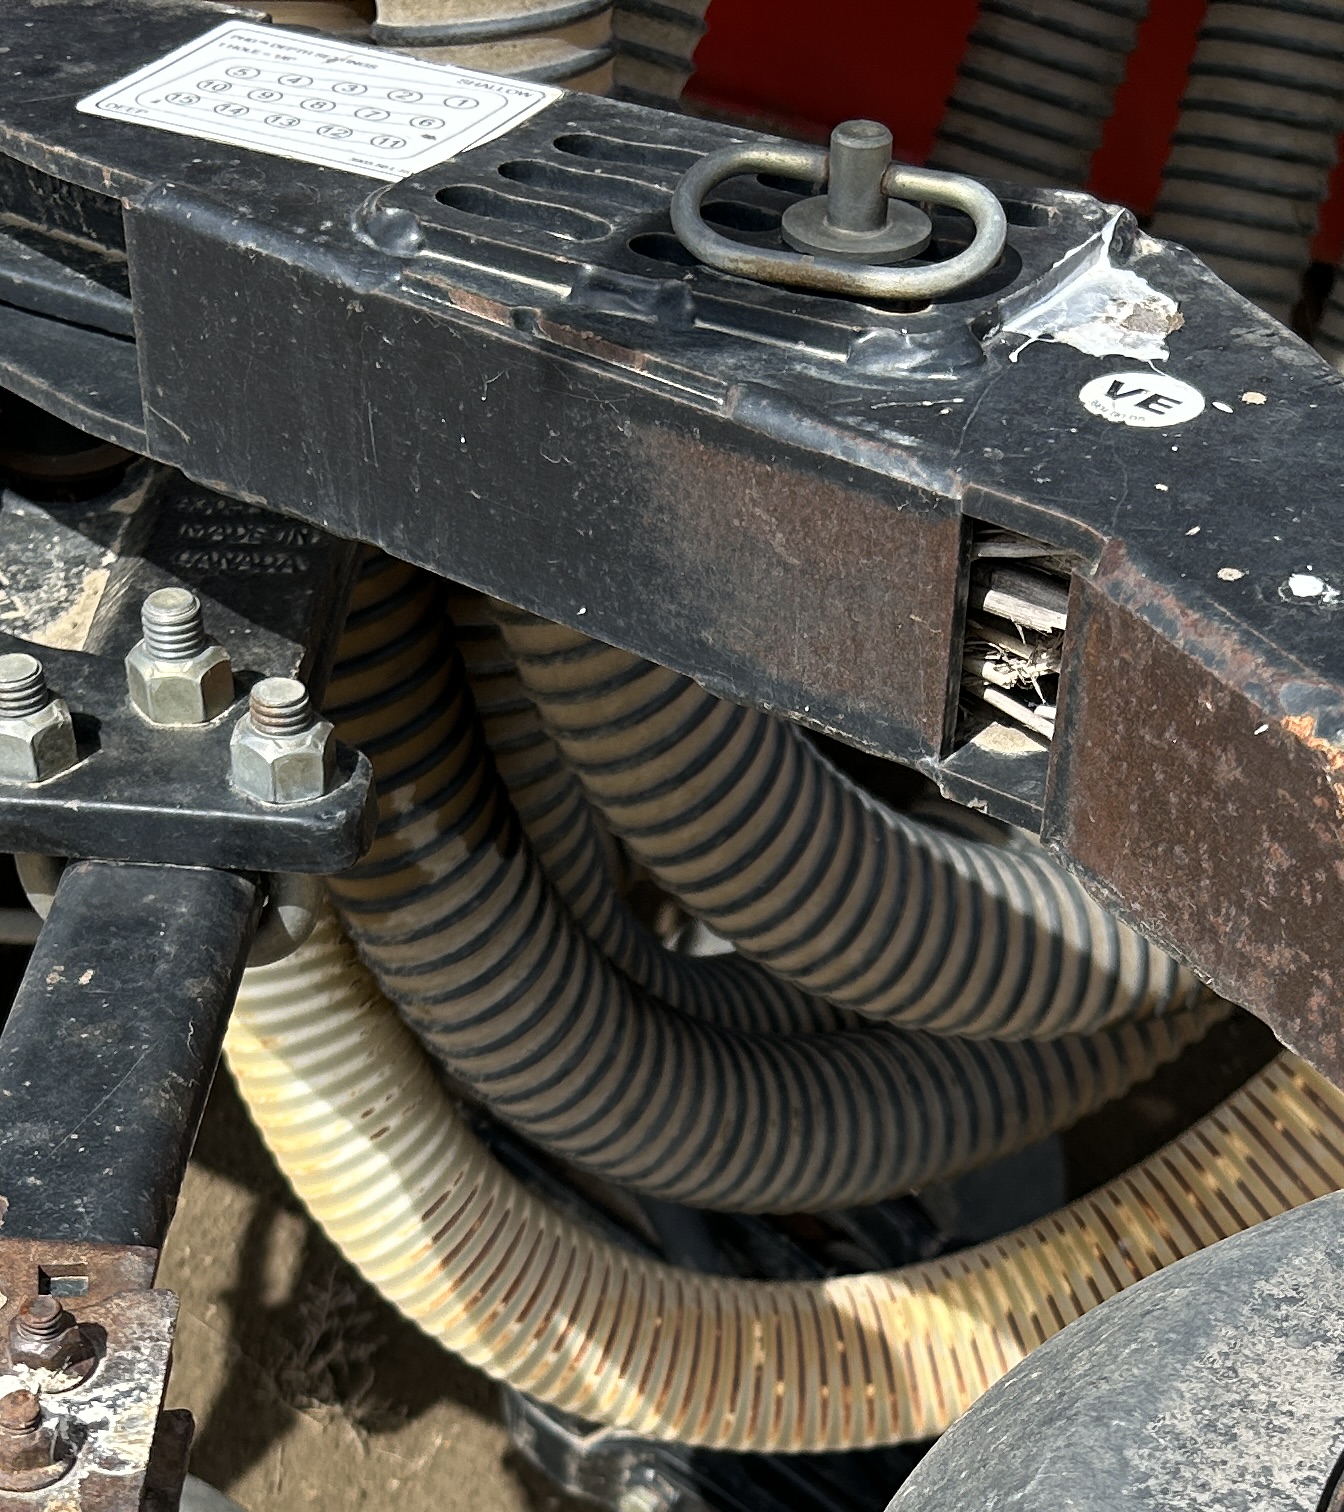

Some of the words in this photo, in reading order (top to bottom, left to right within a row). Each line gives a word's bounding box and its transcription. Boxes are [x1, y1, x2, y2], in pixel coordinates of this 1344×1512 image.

[203, 81, 228, 92] 10
[457, 79, 534, 98] SHALLOW
[104, 102, 150, 114] DEEP
[171, 93, 195, 105] 15
[219, 104, 244, 116] 14
[271, 115, 297, 127] 13
[322, 126, 349, 137] 12
[378, 137, 399, 149] 11
[1103, 379, 1185, 416] VE
